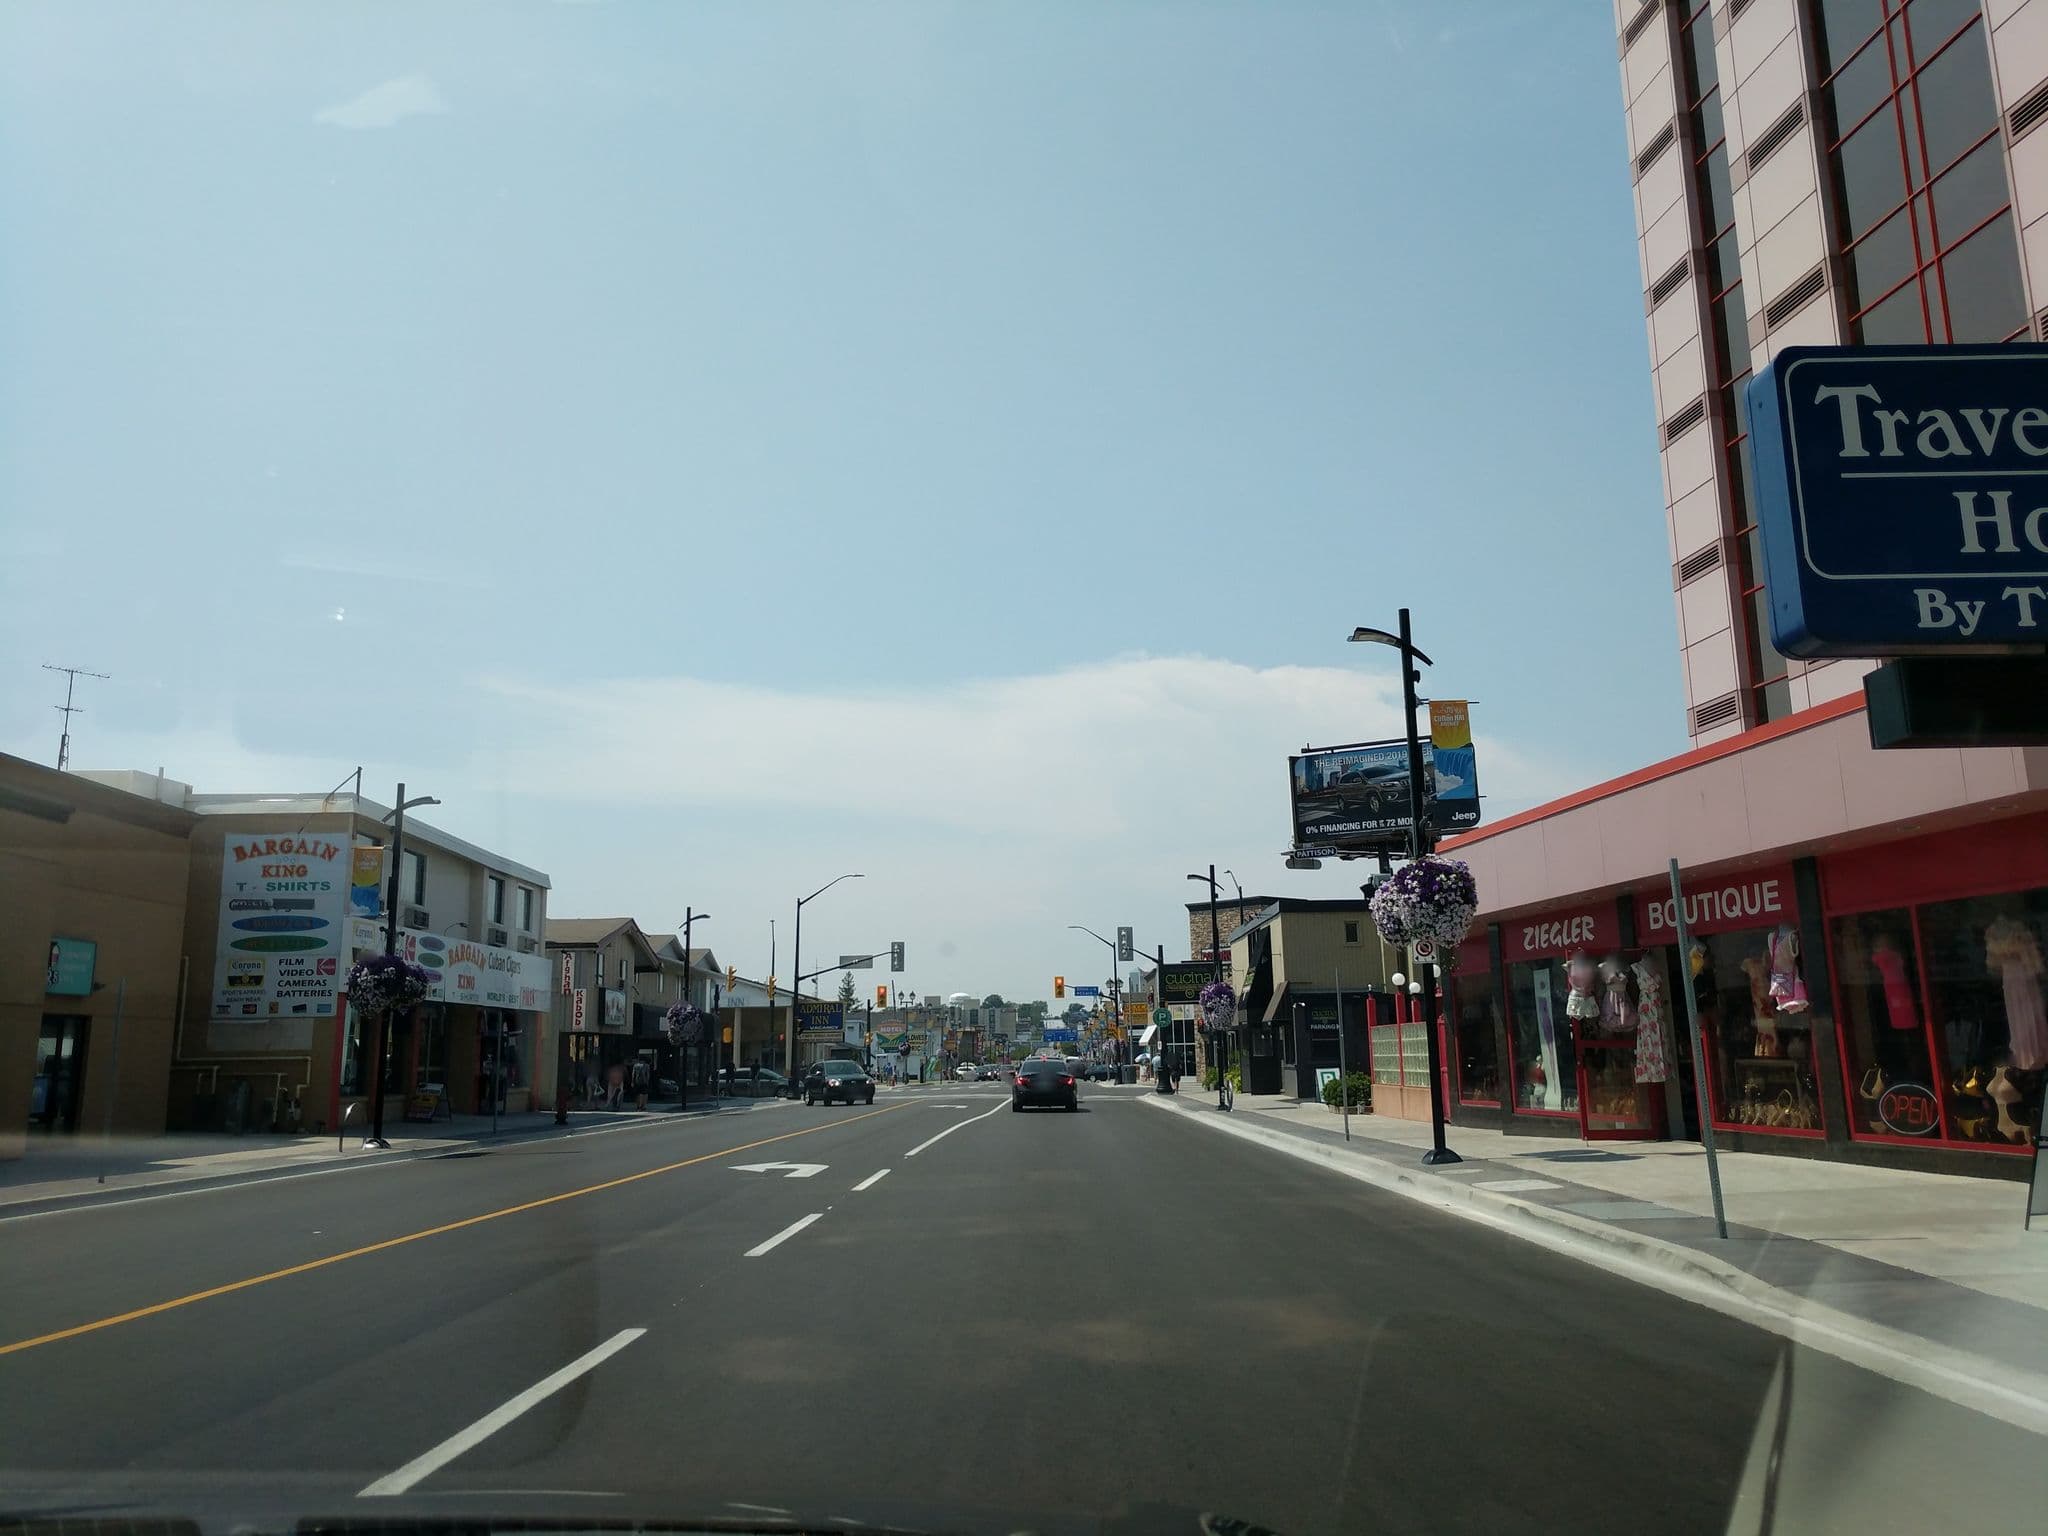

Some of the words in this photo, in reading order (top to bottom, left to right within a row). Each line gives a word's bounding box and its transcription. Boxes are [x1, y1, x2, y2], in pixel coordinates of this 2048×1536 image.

[1913, 587, 1986, 636] By
[2001, 585, 2048, 628] T
[1313, 758, 1330, 768] THE
[1333, 752, 1385, 768] REIMAGINED
[1387, 750, 1408, 762] 2019
[1451, 811, 1477, 821] Jeep
[1305, 824, 1319, 834] 0%
[1320, 821, 1362, 833] FINANCING
[1362, 819, 1378, 829] FOR
[1385, 817, 1396, 827] 72
[232, 837, 339, 863] BARGAIN
[1296, 848, 1335, 858] PATTISON
[260, 864, 308, 878] KING
[265, 881, 331, 892] SHIRTS
[1647, 879, 1782, 930] BOUTIQUE
[1522, 915, 1595, 951] ZIEGLER
[231, 960, 261, 970] Corona
[278, 958, 305, 966] FILM
[448, 944, 486, 973] BARGAIN
[488, 951, 505, 972] Cuban
[506, 956, 521, 977] Cigars
[278, 968, 315, 977] VIDEO
[562, 952, 573, 995] Afghan
[1165, 971, 1212, 985] cucina
[277, 979, 328, 988] CAMERAS
[457, 974, 476, 991] KING
[276, 989, 333, 998] BATTERIES
[574, 990, 584, 1026] Kabob
[727, 997, 745, 1007] INN
[799, 1003, 842, 1014] ADMIRAL
[811, 1015, 830, 1025] INN
[1158, 1012, 1166, 1021] P
[1882, 1093, 1935, 1126] OPEN
